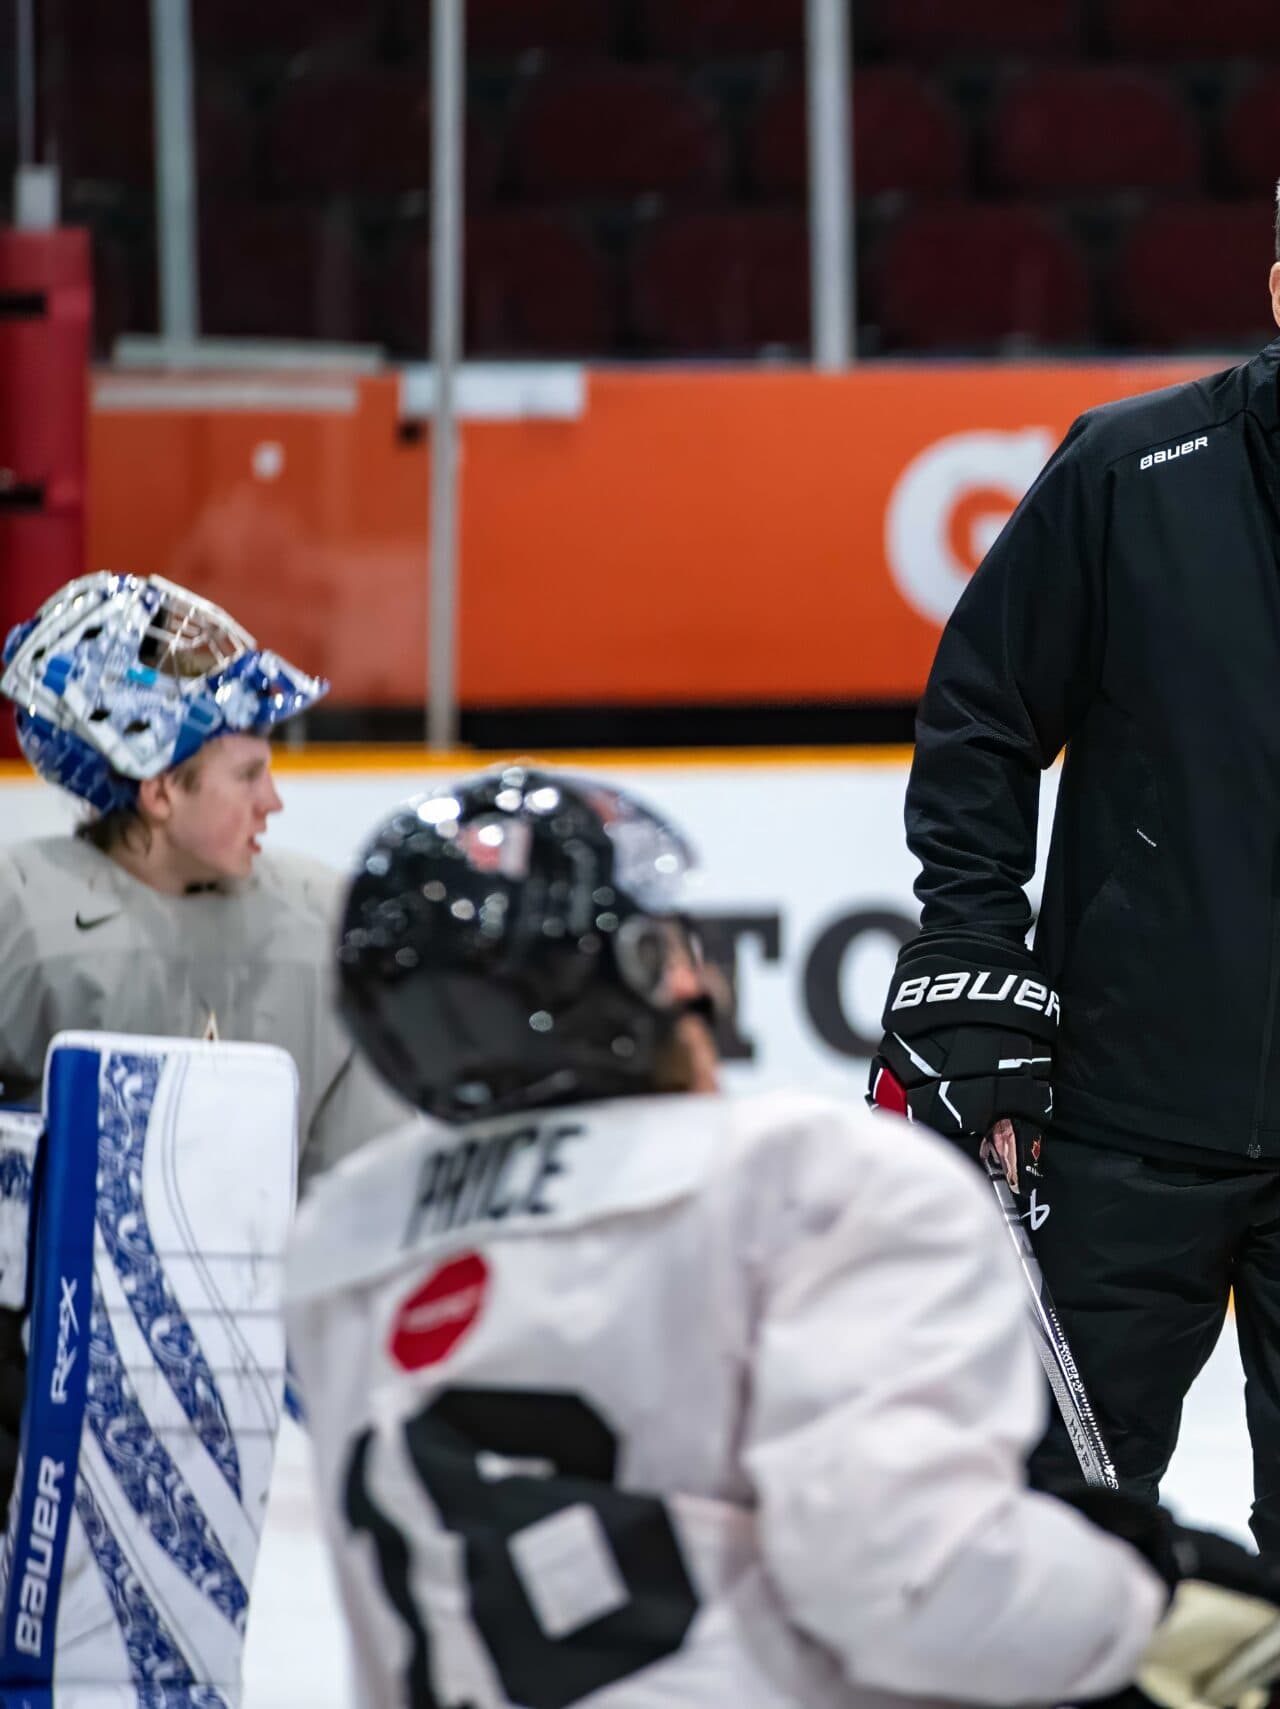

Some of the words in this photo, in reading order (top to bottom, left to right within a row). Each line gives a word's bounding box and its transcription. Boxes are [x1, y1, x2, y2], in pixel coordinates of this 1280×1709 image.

[1139, 435, 1209, 471] BAUER
[891, 971, 1061, 1027] BAUER
[13, 1454, 66, 1659] BAUER
